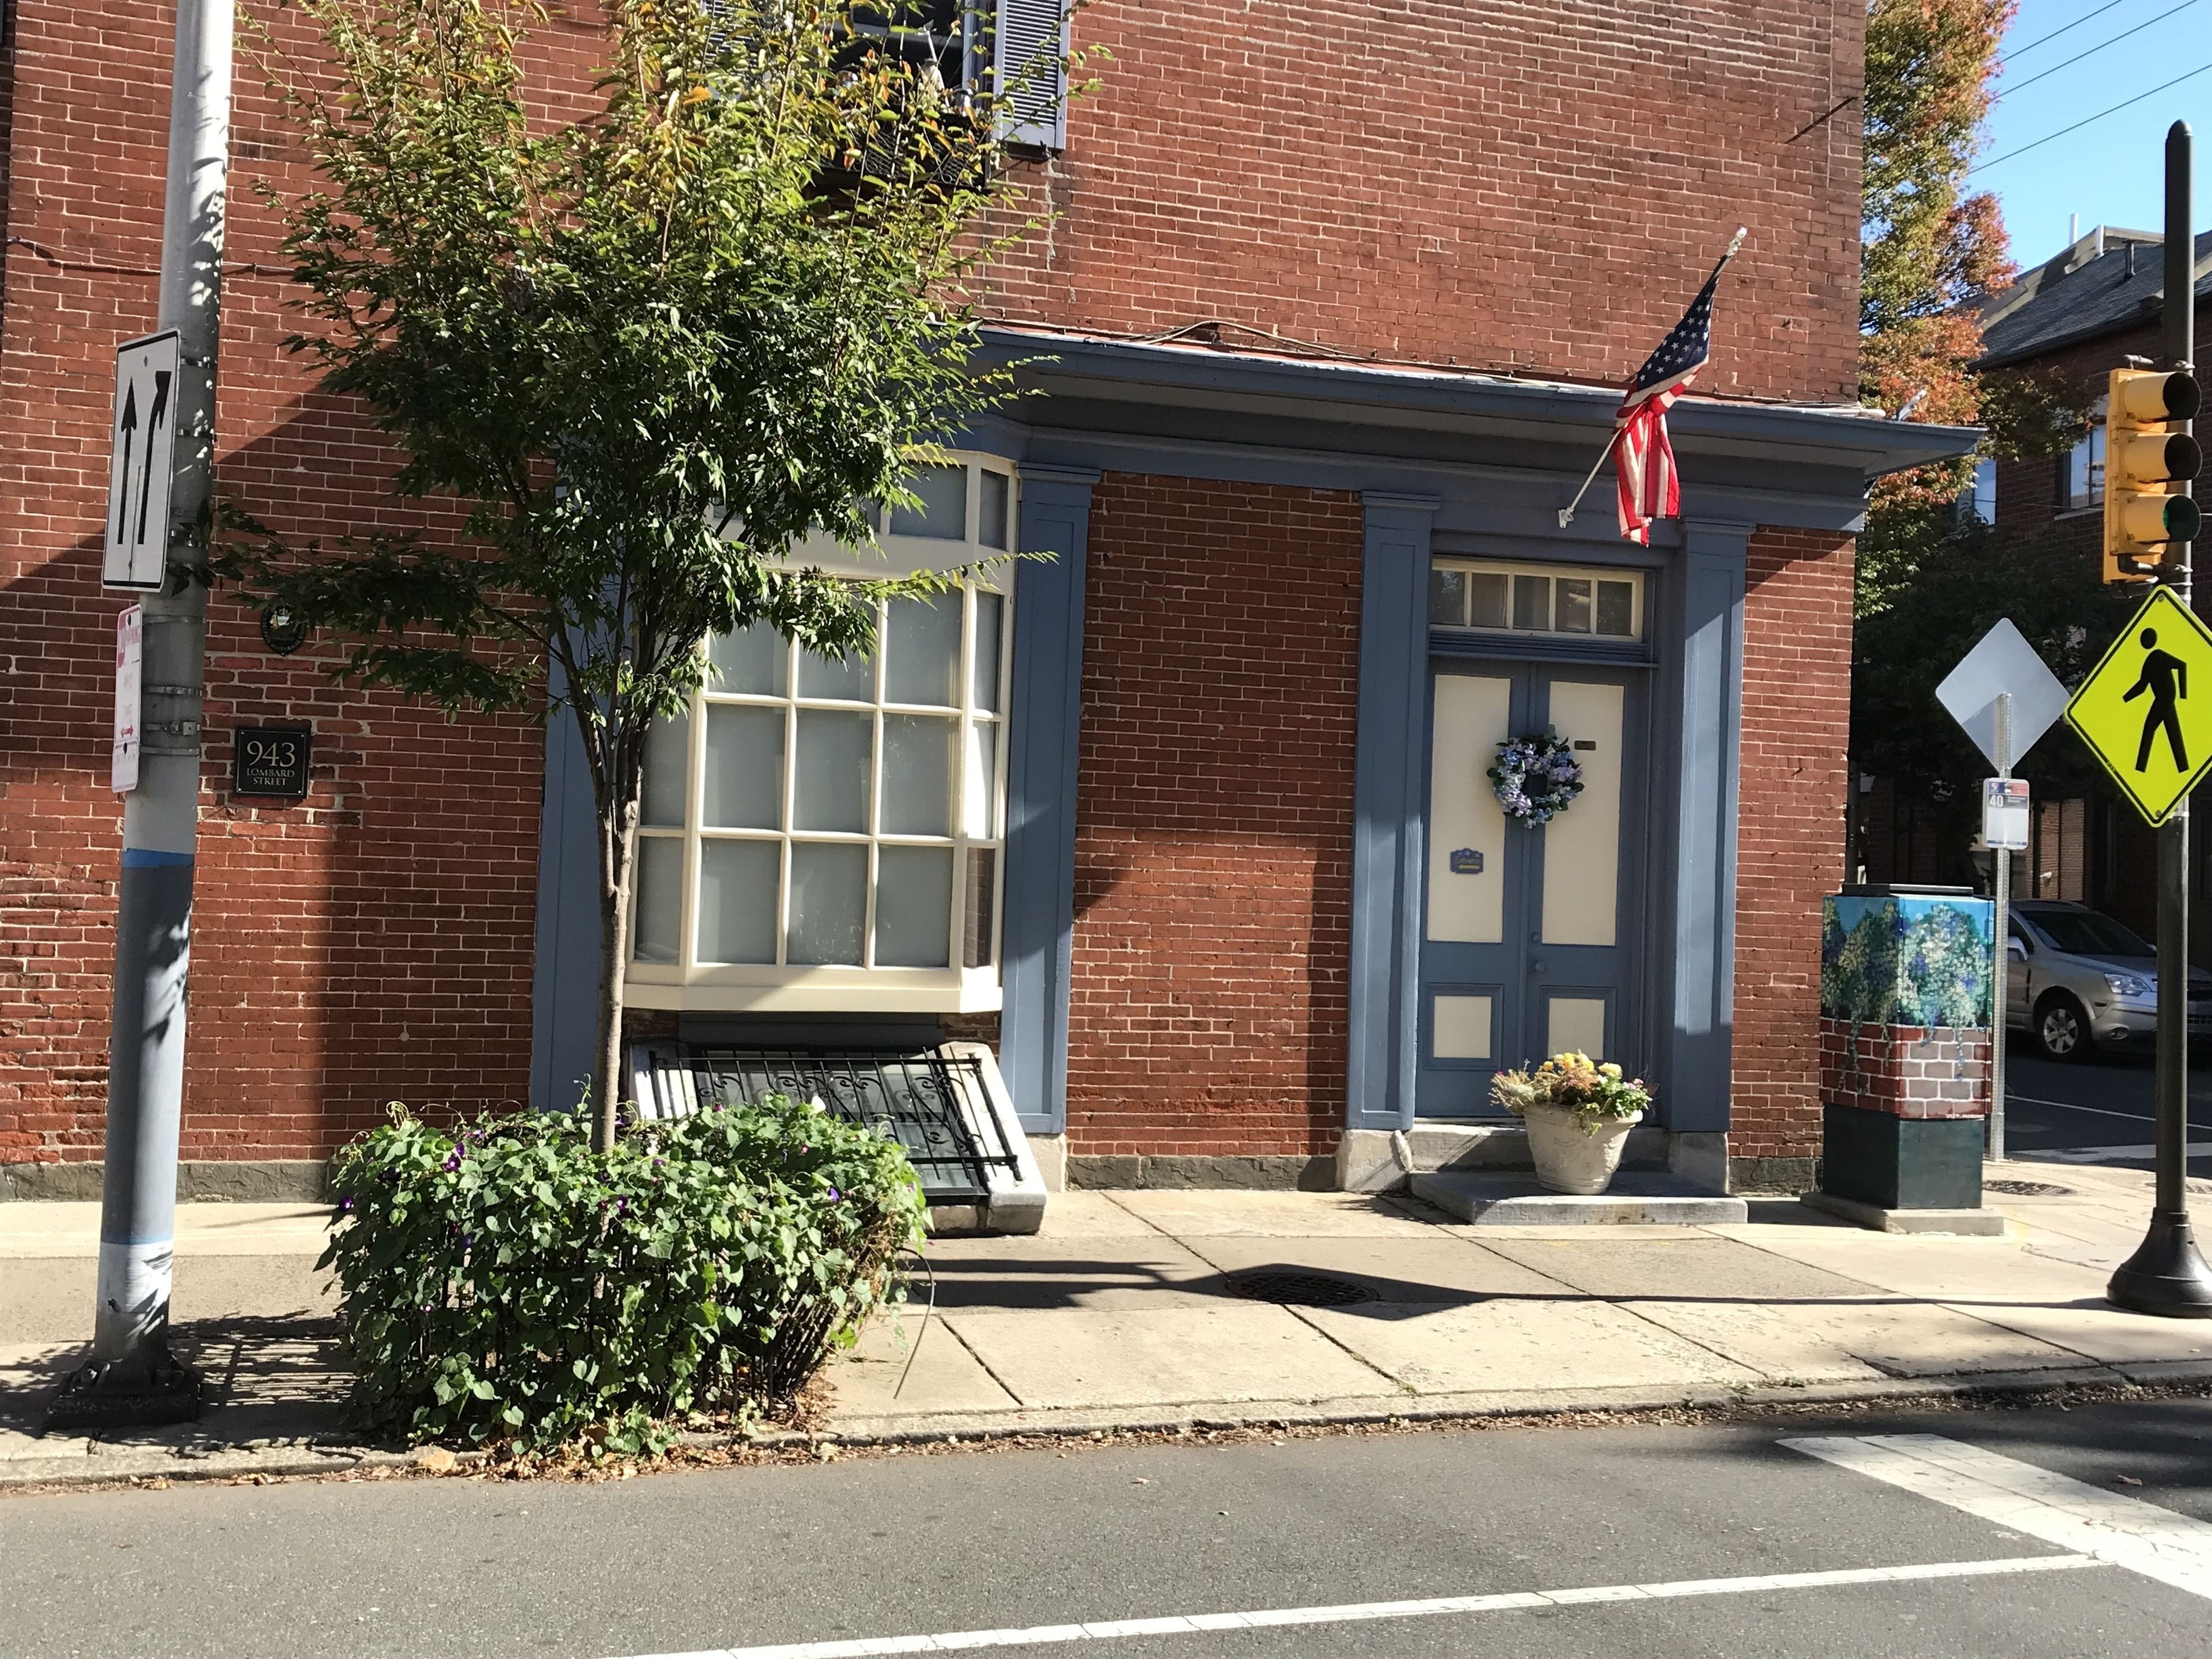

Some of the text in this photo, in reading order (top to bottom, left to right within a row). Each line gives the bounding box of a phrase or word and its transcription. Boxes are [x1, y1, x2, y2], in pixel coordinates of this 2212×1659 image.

[247, 741, 296, 767] 943
[247, 768, 295, 778] LOMBARD
[253, 777, 287, 786] STREET
[1989, 794, 2004, 807] 40
